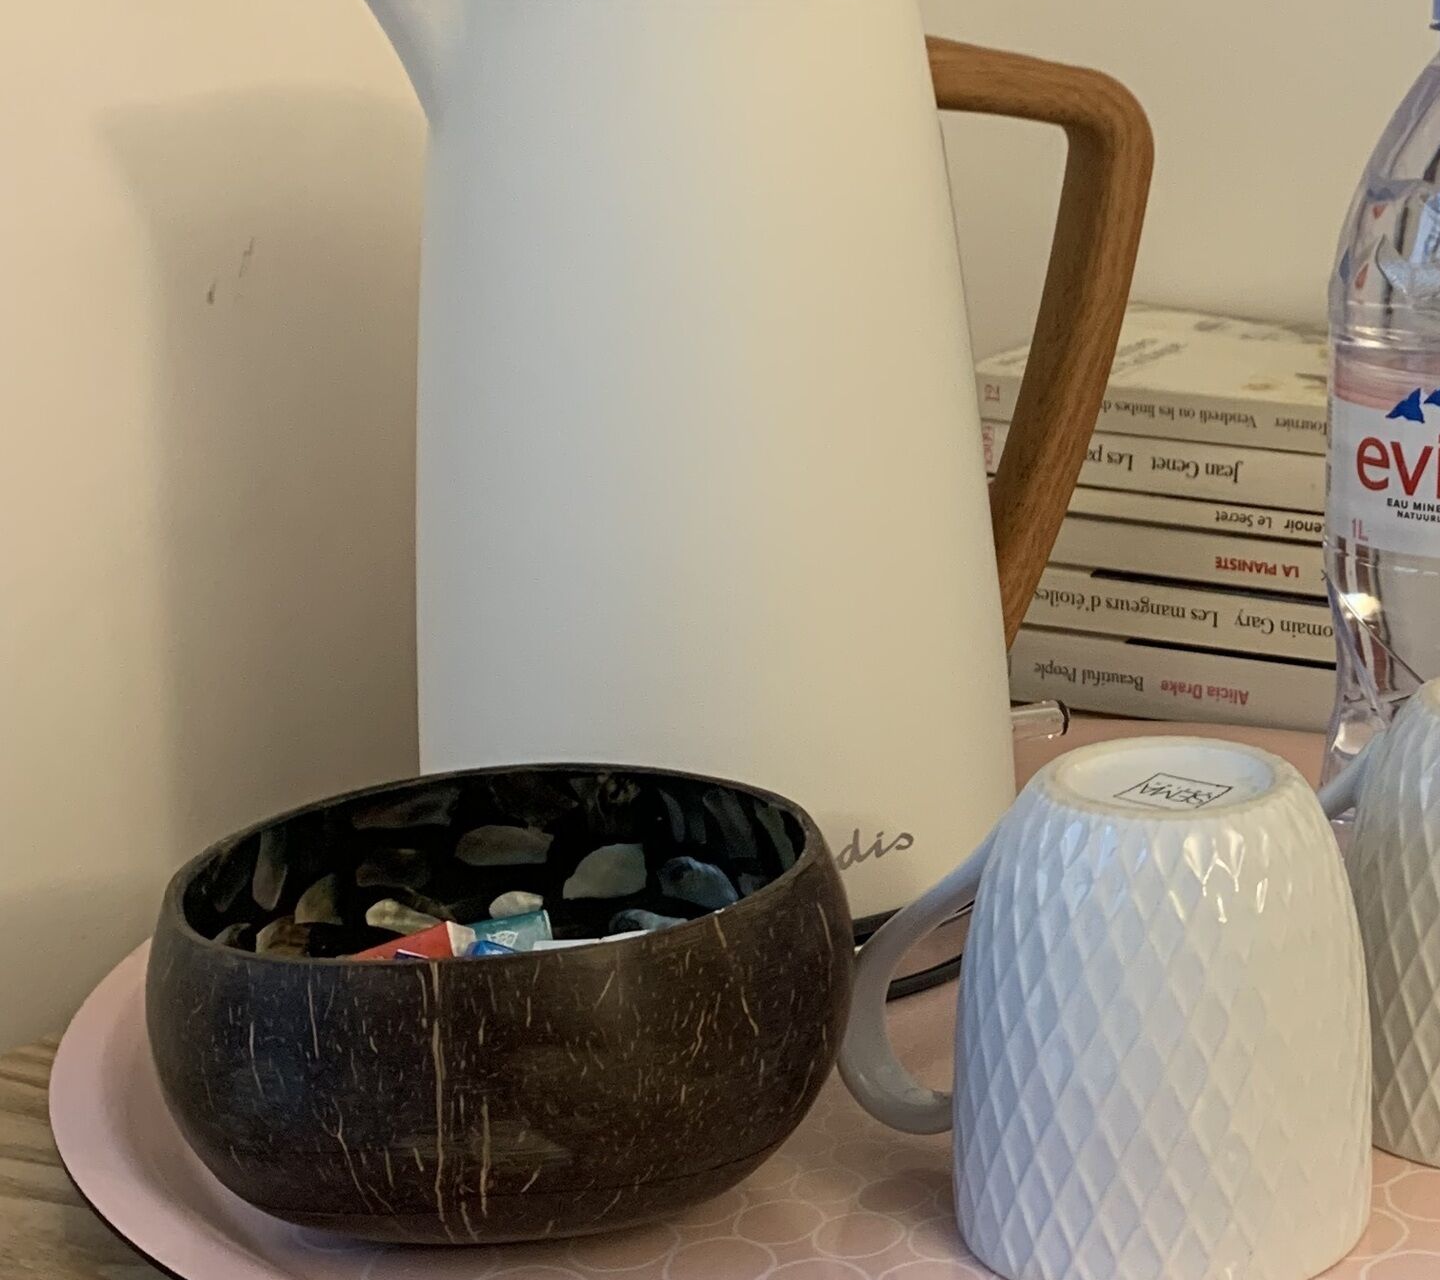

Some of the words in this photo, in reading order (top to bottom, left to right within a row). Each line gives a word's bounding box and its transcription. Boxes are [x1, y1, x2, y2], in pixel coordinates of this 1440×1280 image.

[1114, 401, 1156, 419] limbes
[1158, 406, 1176, 421] les
[1179, 409, 1196, 420] ou
[1199, 408, 1258, 429] Vendredi
[1107, 453, 1135, 472] Les
[1150, 458, 1201, 480] Genet
[1205, 460, 1244, 484] Jean
[1386, 498, 1409, 510] EAU
[1215, 510, 1254, 527] Secret
[1258, 516, 1273, 529] Le
[1283, 519, 1326, 534] enoir
[1215, 556, 1278, 577] PIANISTE
[1281, 565, 1299, 578] LA
[1105, 597, 1186, 621] mangeurs
[1191, 608, 1218, 628] Les
[1233, 609, 1275, 635] Gary
[1280, 620, 1334, 640] omain
[1033, 661, 1077, 686] People
[1082, 666, 1144, 692] Beautiful
[1160, 679, 1203, 700] Drake
[1206, 684, 1249, 706] Alicia
